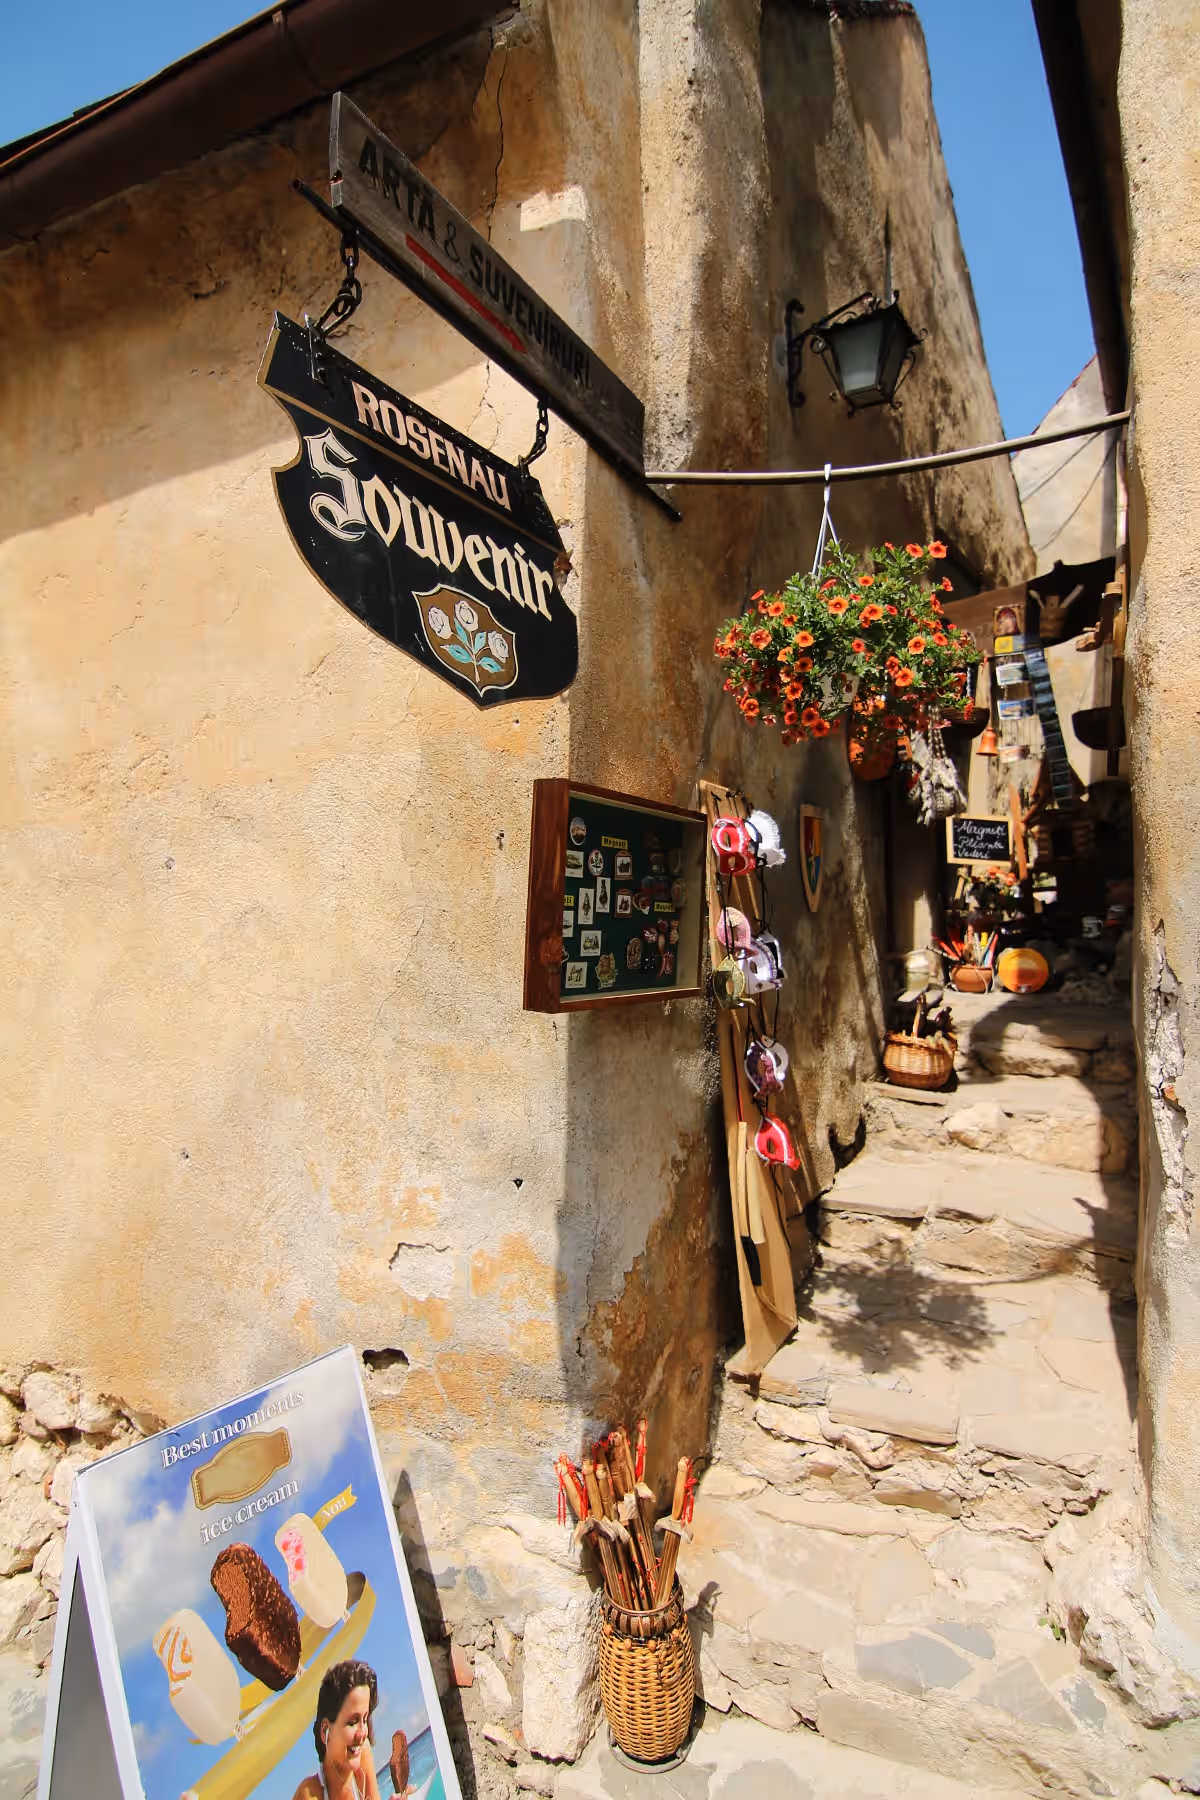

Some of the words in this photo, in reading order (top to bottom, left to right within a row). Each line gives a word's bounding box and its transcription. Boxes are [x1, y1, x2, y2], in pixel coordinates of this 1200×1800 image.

[359, 136, 437, 244] ARTA
[444, 221, 460, 263] &
[470, 243, 594, 390] SUVENIRURI
[348, 381, 512, 511] ROSENAU
[303, 427, 554, 622] Souvenir
[160, 1430, 210, 1469] Best
[212, 1391, 304, 1445] moments
[200, 1516, 233, 1545] ice
[235, 1480, 300, 1525] cream
